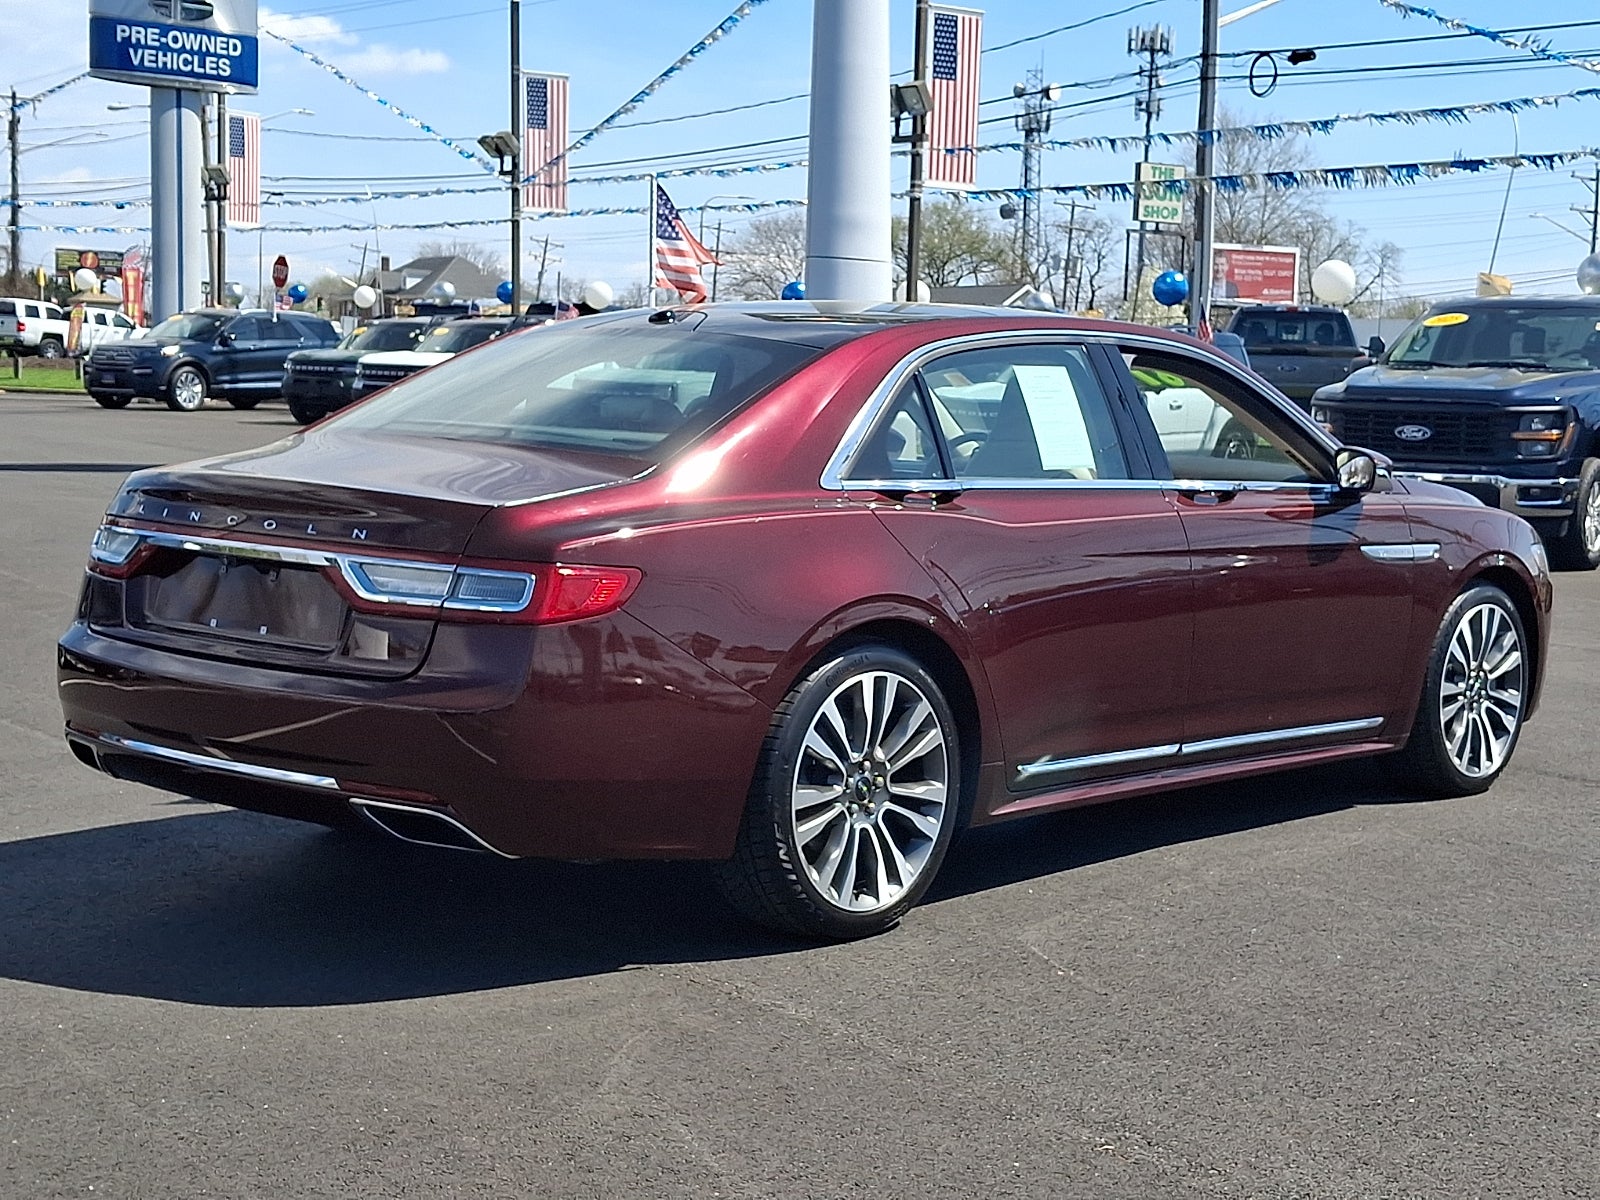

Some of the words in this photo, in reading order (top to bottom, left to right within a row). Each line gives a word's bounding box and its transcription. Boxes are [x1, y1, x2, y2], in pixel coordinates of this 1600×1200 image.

[116, 24, 242, 57] PRE-OWNED
[128, 47, 232, 77] VEHICLES
[1150, 166, 1175, 179] THE
[1143, 205, 1179, 220] SHOP
[138, 504, 368, 540] LINCOLN
